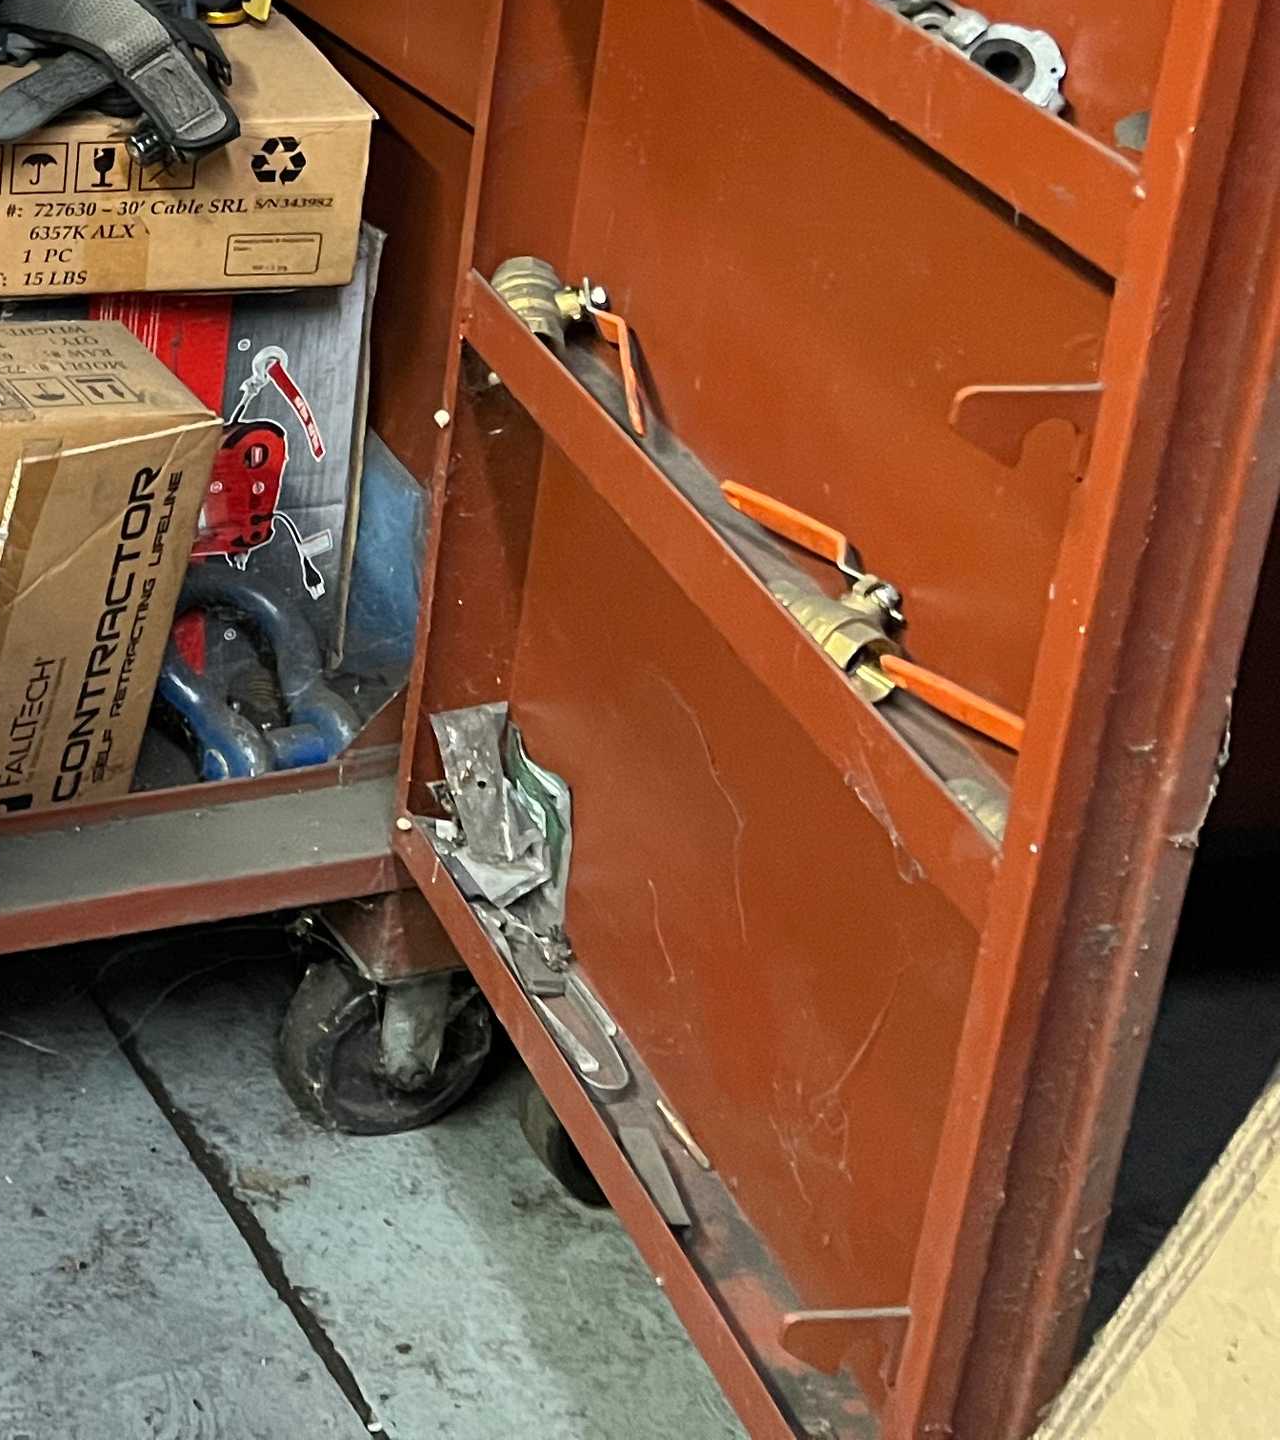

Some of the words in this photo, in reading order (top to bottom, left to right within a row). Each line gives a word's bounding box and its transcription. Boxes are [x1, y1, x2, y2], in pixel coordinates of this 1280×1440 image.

[32, 201, 97, 218] 727630
[150, 199, 204, 215] Cable
[207, 198, 249, 214] SRL
[28, 225, 88, 241] 6357K
[90, 223, 136, 240] ALX
[22, 248, 33, 264] 1
[43, 247, 73, 264] PC
[22, 271, 44, 287] 15
[48, 269, 89, 286] LBS
[51, 465, 162, 803] CONTRACTOR
[91, 727, 115, 785] SELF
[109, 577, 157, 718] RETRACTING
[147, 470, 184, 568] LIFELINE
